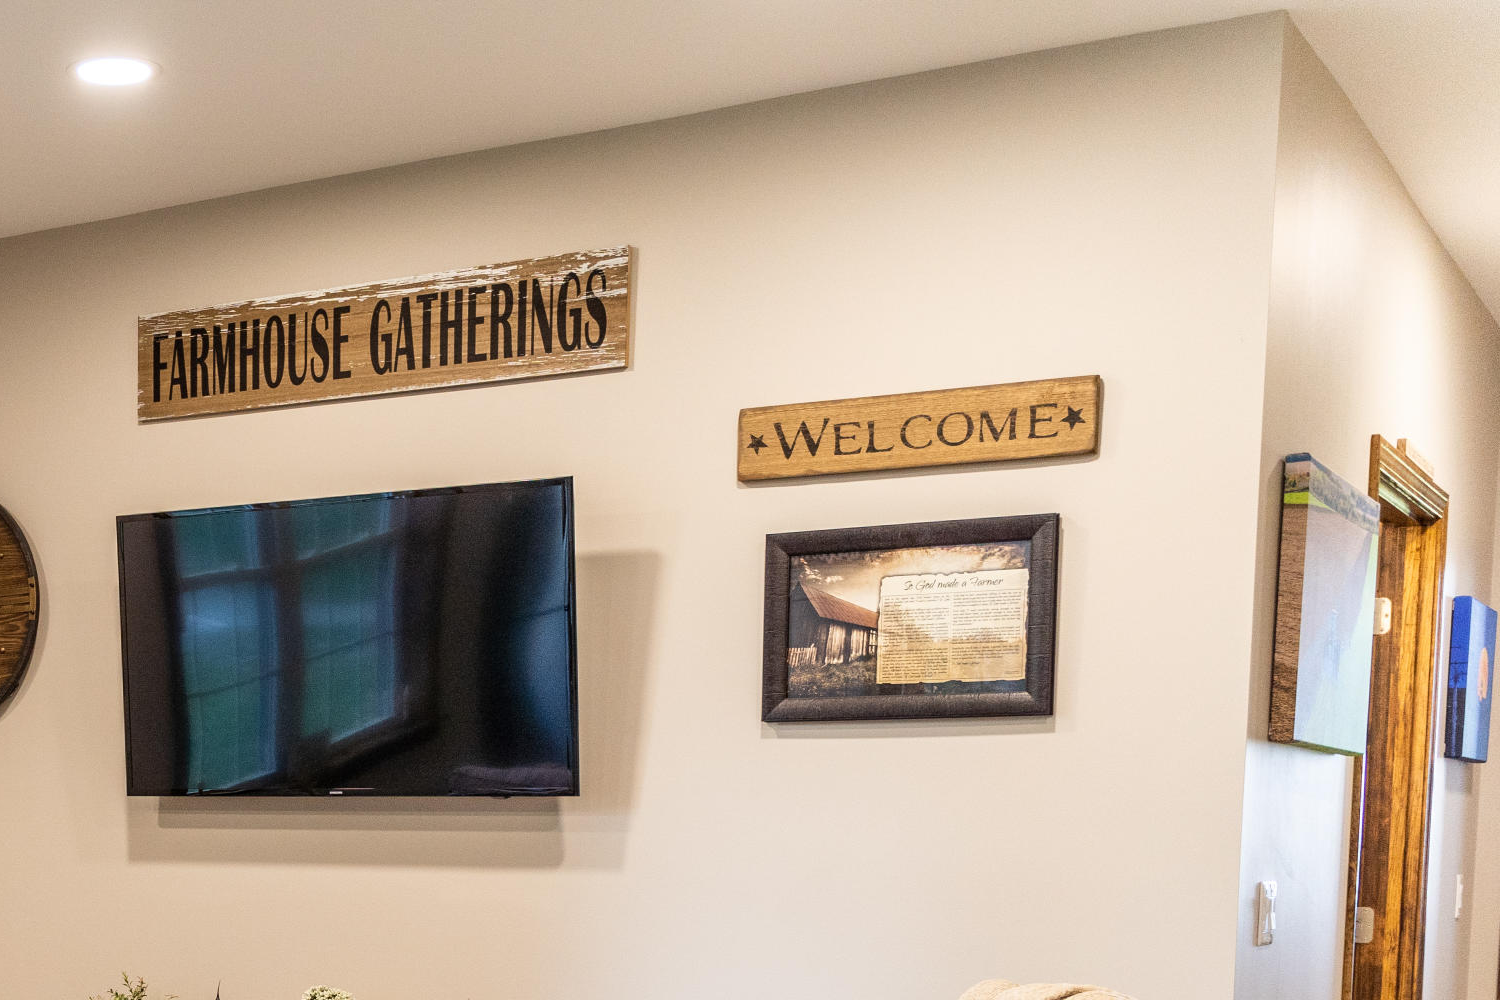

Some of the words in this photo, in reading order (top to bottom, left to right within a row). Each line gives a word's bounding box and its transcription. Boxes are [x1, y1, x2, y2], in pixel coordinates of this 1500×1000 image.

[152, 306, 352, 403] FARMHOUSE
[369, 269, 608, 376] GATHERINGS
[773, 402, 1059, 460] WELCOME
[916, 579, 936, 592] God
[937, 578, 958, 589] made
[969, 576, 1004, 587] Farmer
